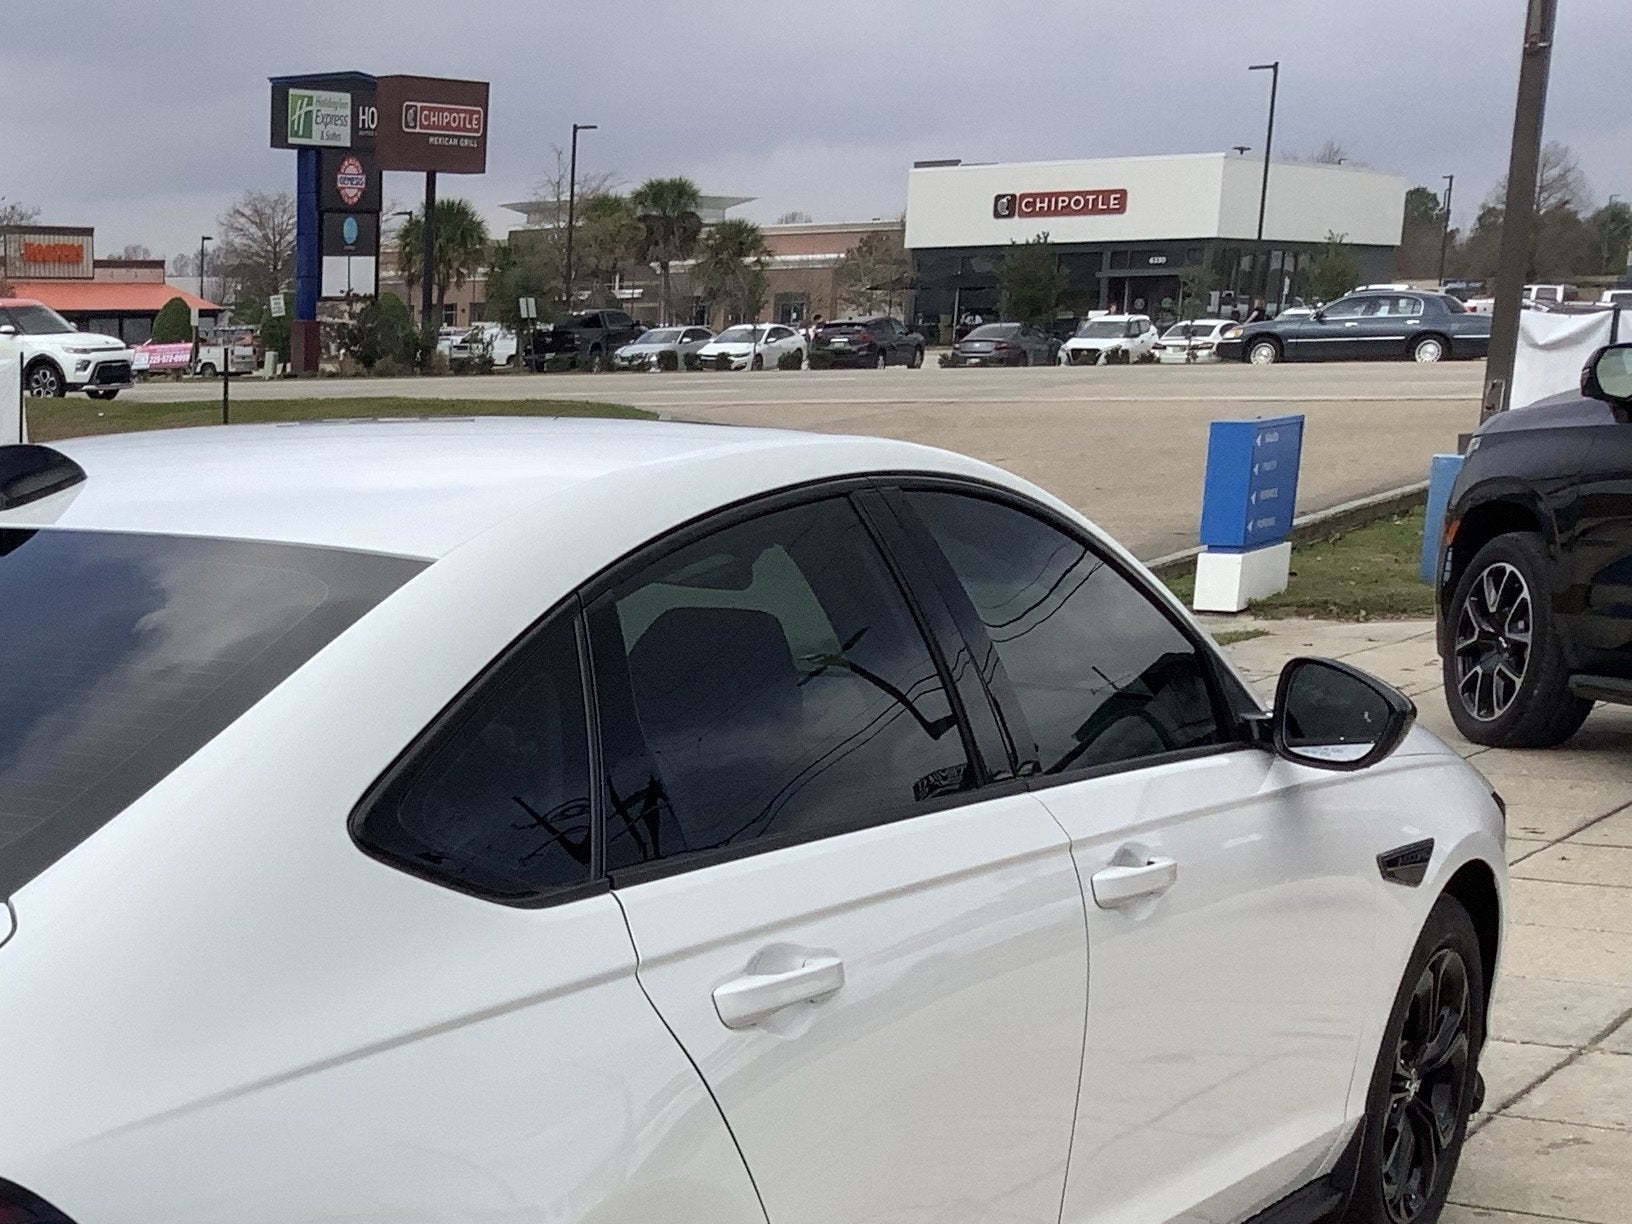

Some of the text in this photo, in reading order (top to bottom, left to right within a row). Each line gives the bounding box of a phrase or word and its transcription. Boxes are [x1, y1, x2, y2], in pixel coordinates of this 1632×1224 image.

[315, 109, 349, 129] Express
[421, 110, 480, 129] CHIPOTLE
[429, 136, 458, 146] MEXICAN
[1021, 193, 1122, 213] CHIPOTLE
